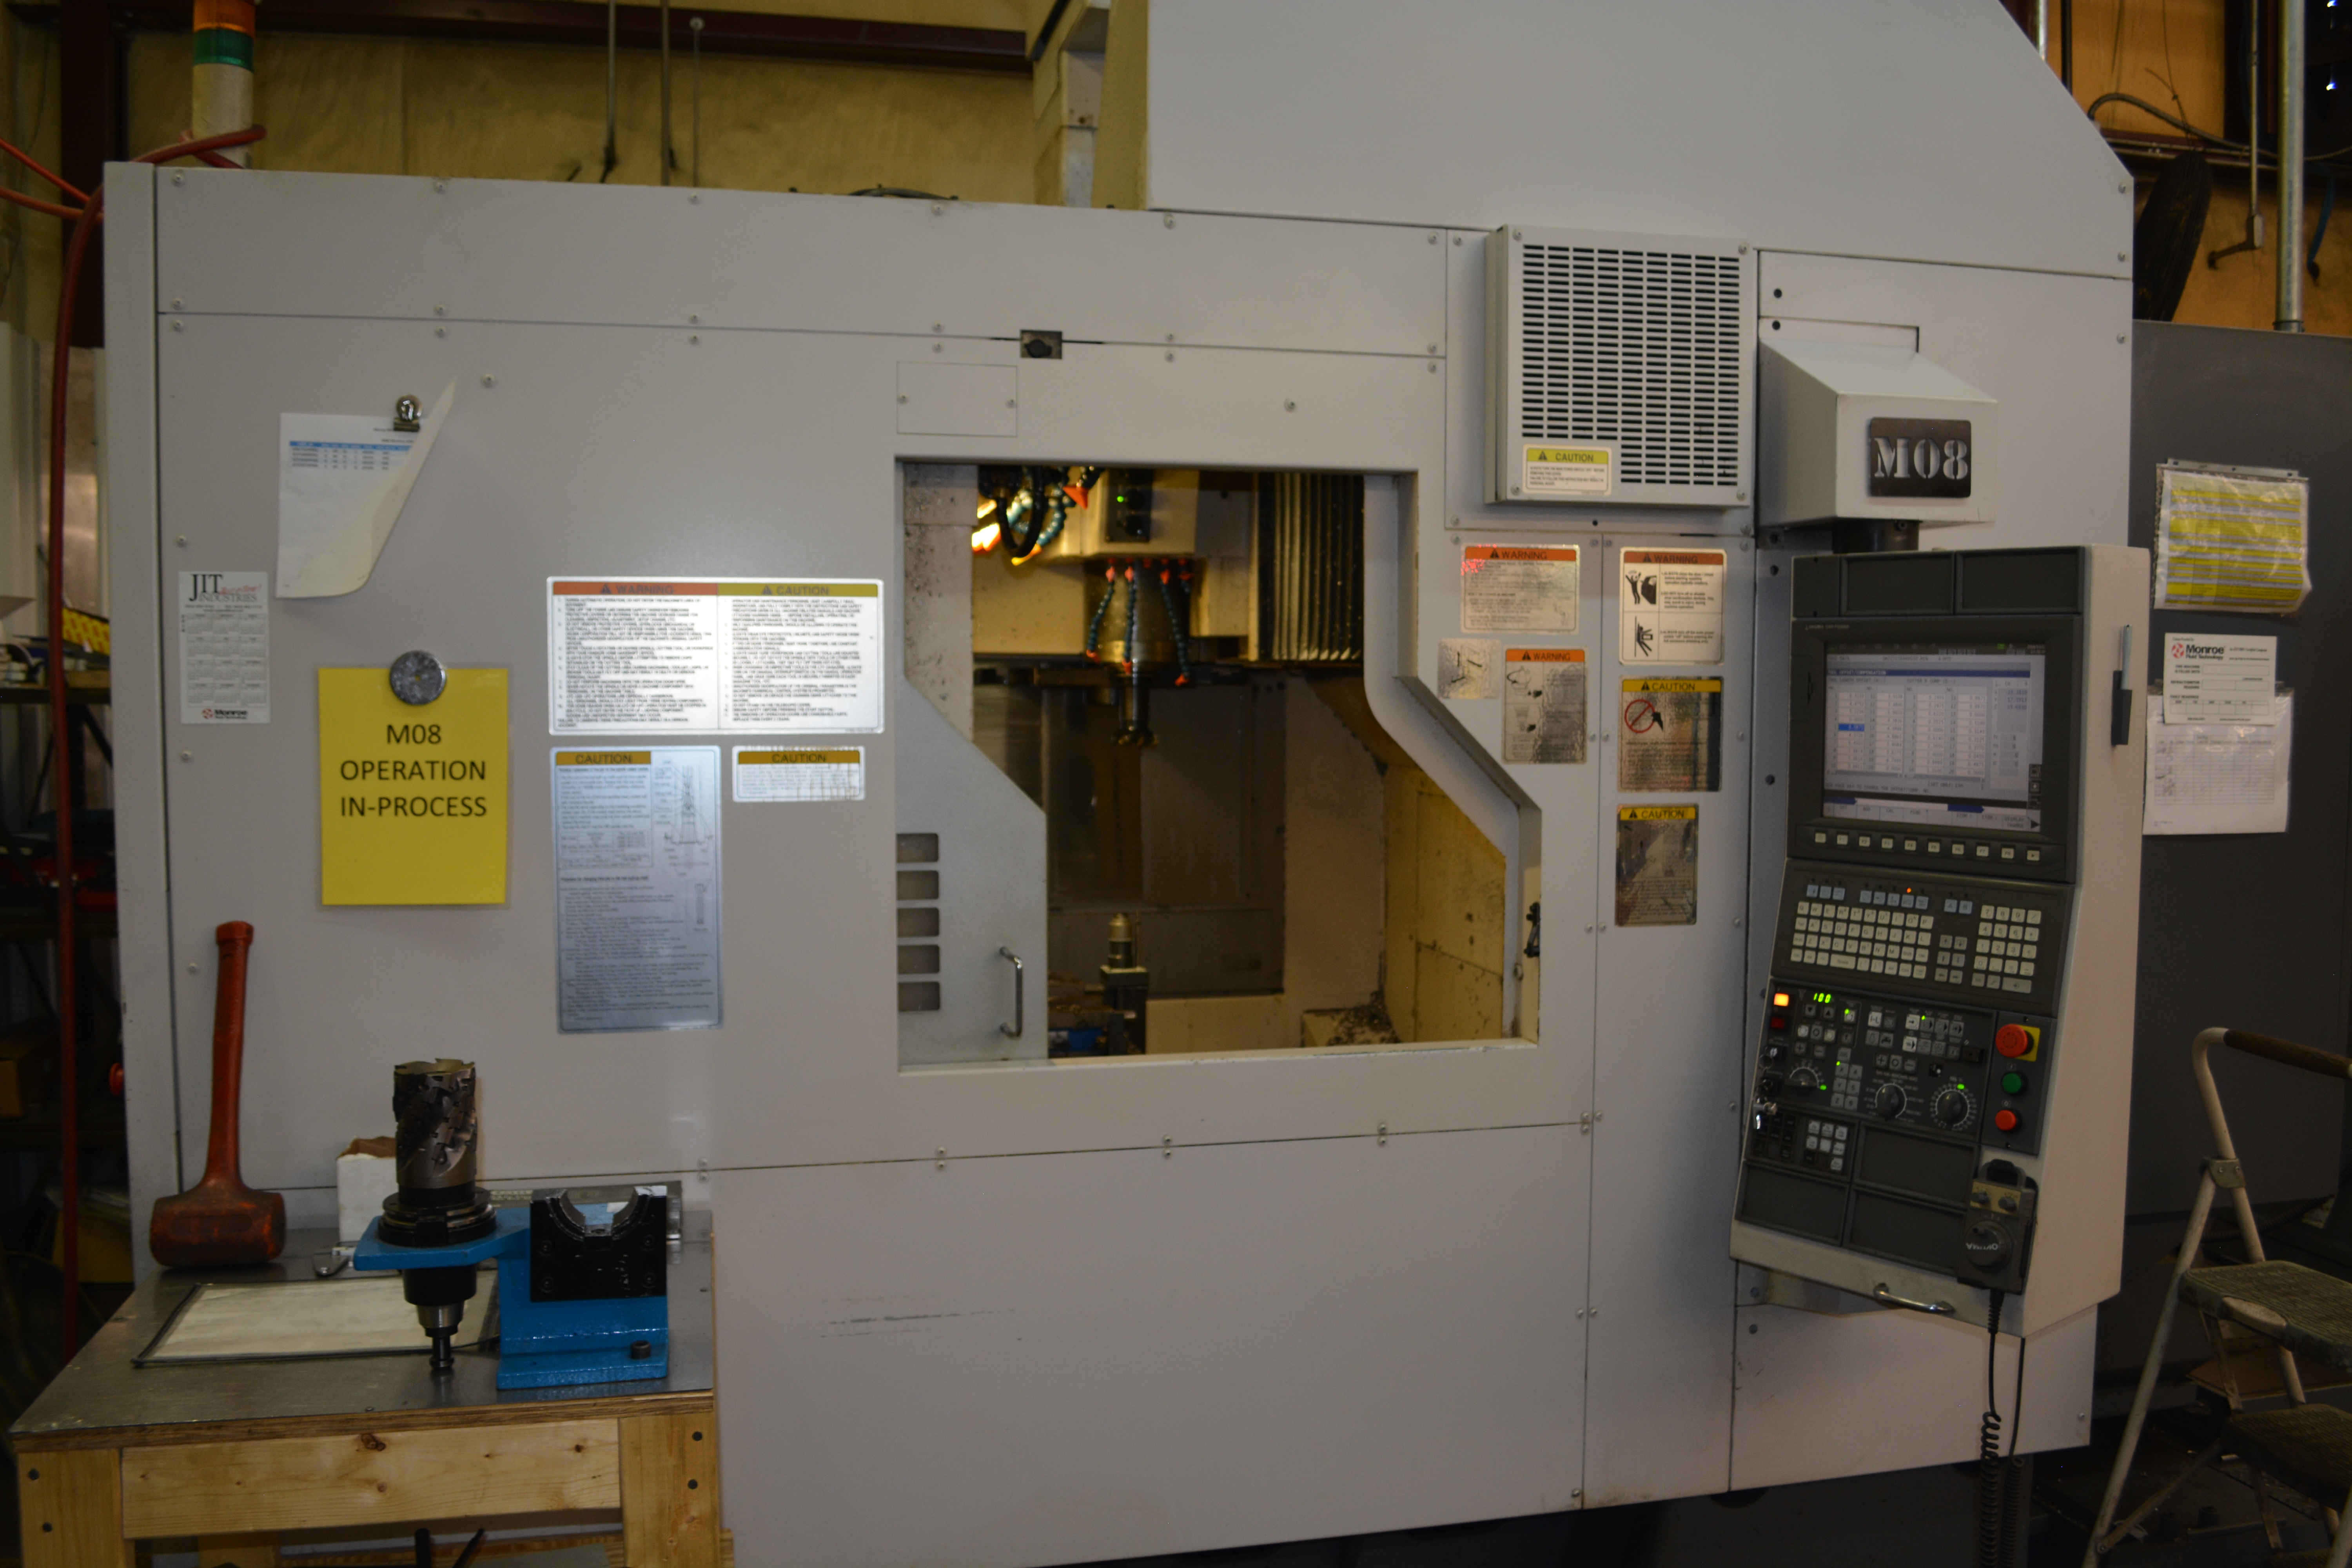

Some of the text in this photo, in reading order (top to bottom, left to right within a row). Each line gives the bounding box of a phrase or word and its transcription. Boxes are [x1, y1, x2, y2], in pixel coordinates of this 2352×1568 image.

[1555, 452, 1593, 462] CAUTION
[1874, 436, 1968, 480] M08
[1501, 550, 1548, 559] WARNING
[1654, 555, 1699, 564] WARNING
[189, 573, 223, 601] JIT
[616, 585, 674, 595] WARNING
[776, 586, 829, 595] CAUTION
[2186, 644, 2224, 654] Monroe
[1533, 652, 1571, 662] WARNING
[1652, 682, 1696, 692] CAUTION
[387, 724, 441, 744] M08
[575, 755, 632, 764] CAUTION
[771, 753, 826, 763] CAUTION
[340, 760, 486, 780] OPERATION
[341, 796, 487, 817] IN-PROCESS
[1641, 809, 1684, 819] CAUTION
[1813, 993, 1831, 1004] 100
